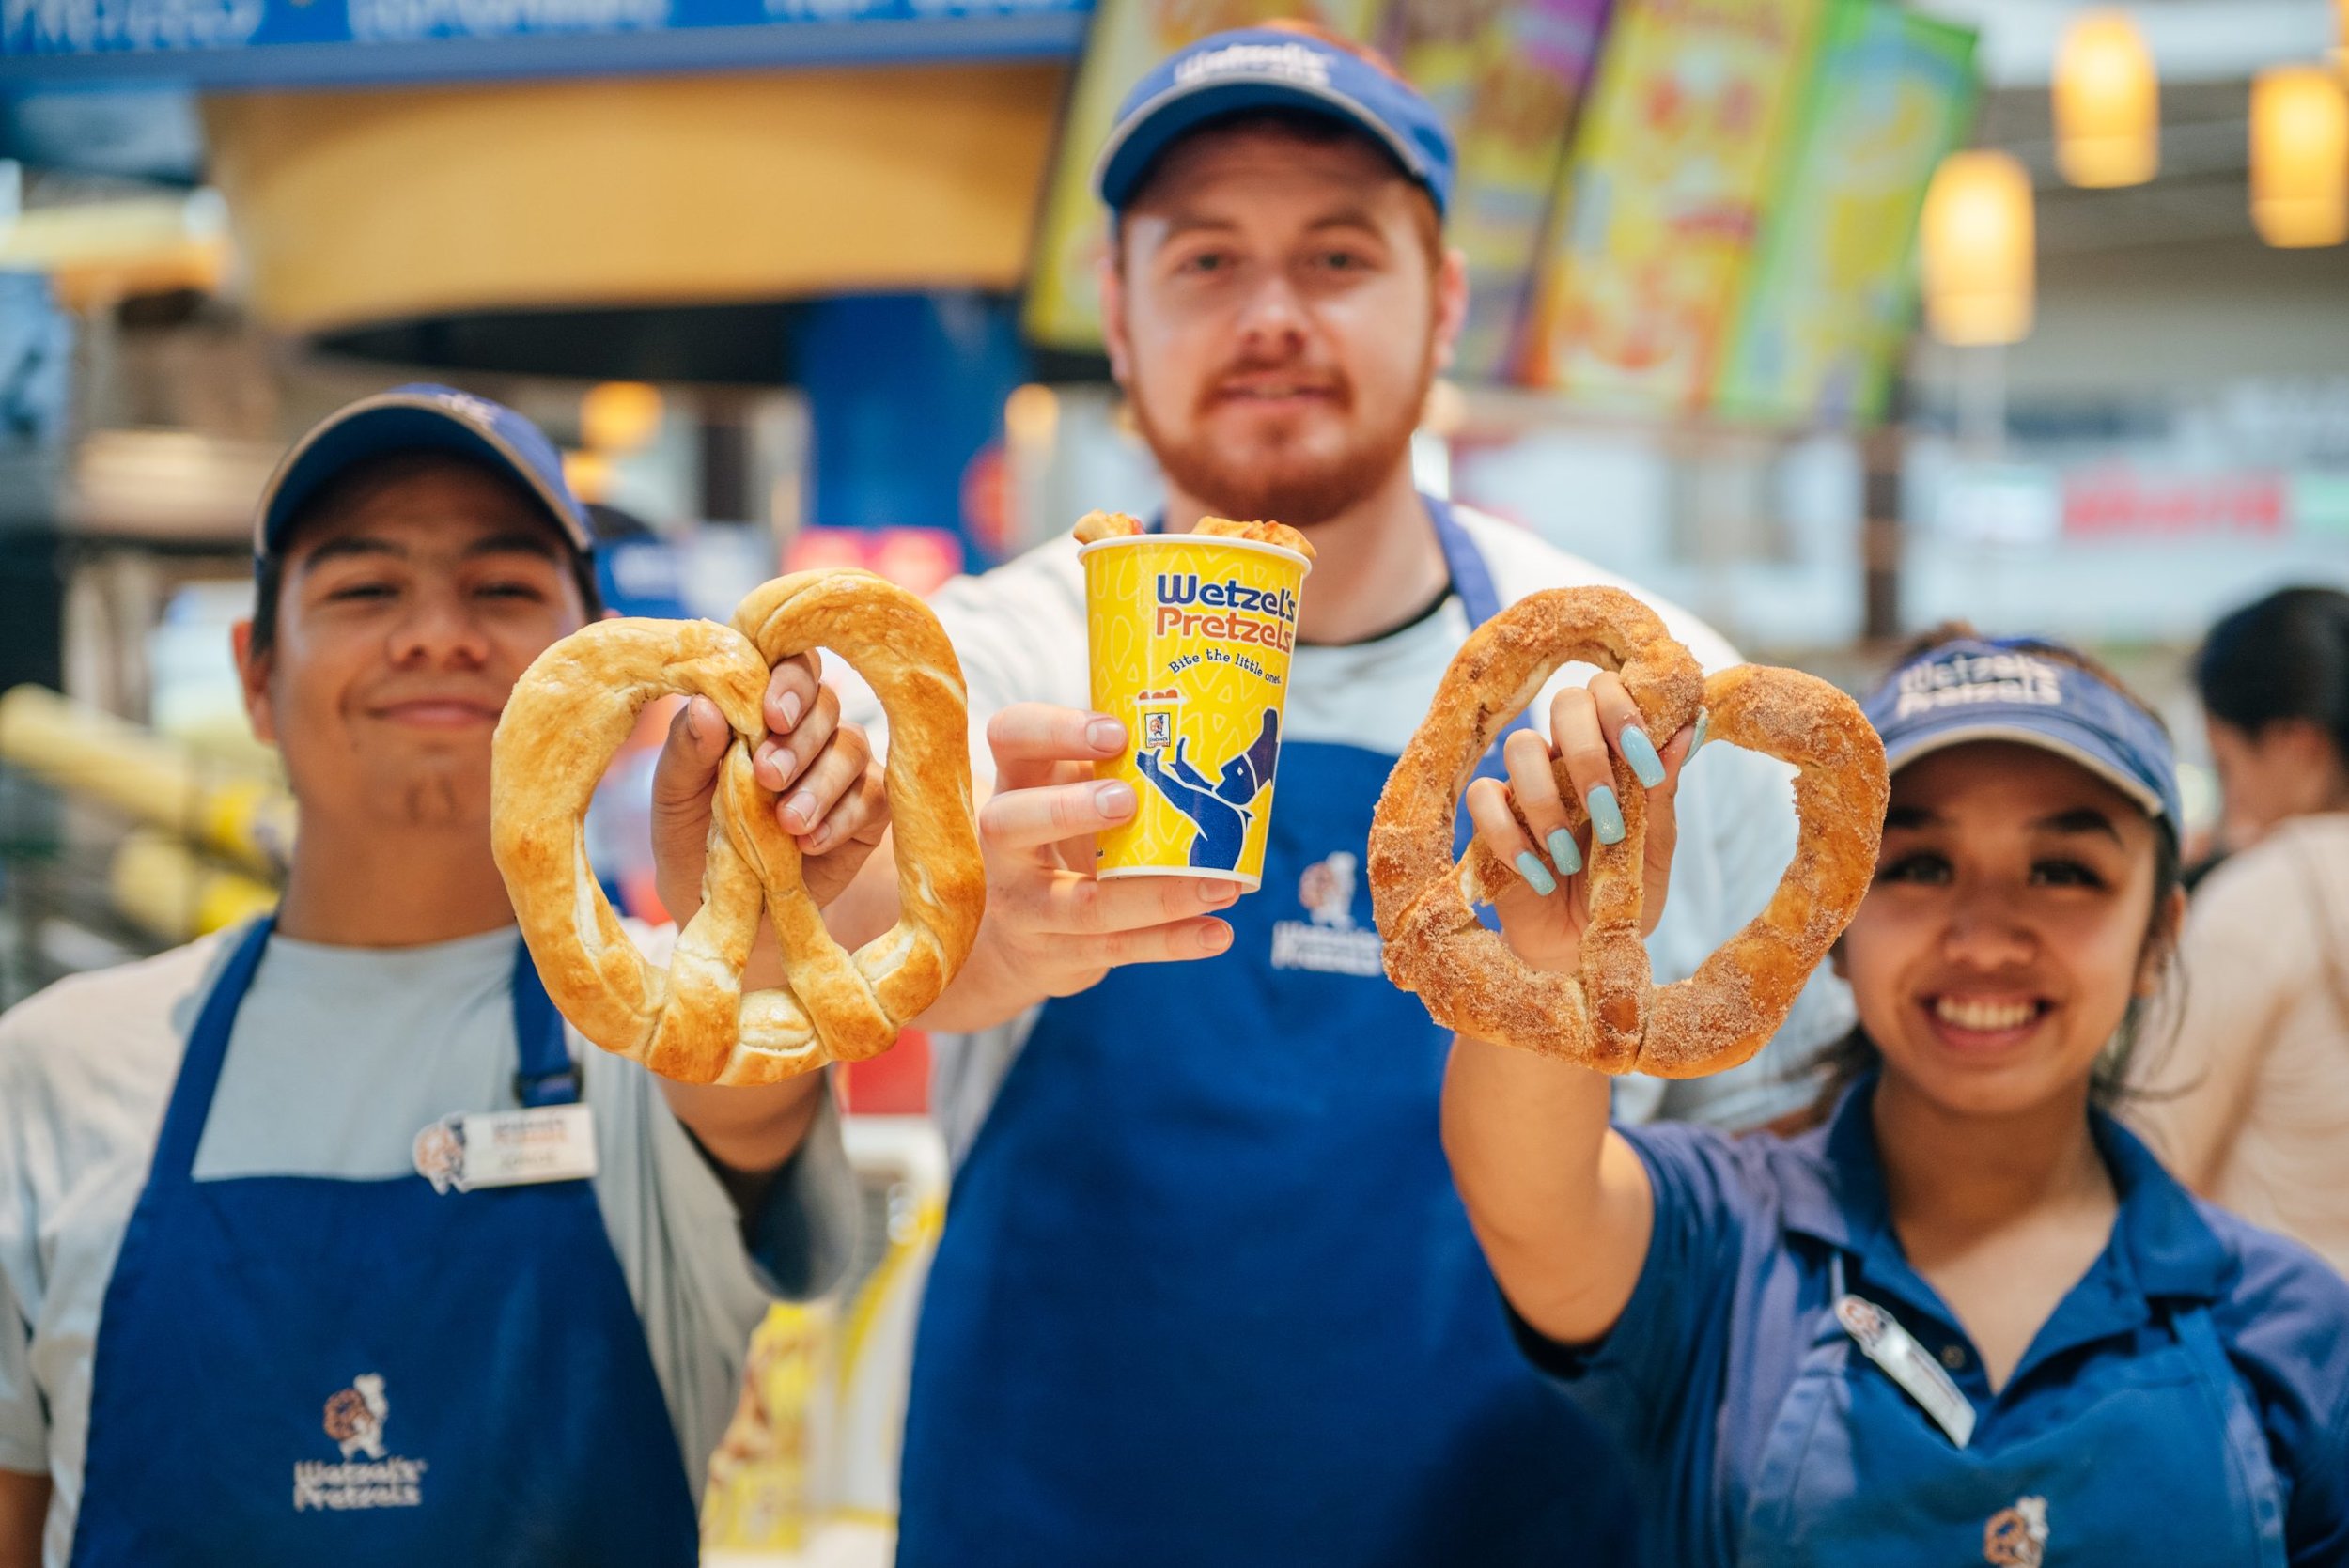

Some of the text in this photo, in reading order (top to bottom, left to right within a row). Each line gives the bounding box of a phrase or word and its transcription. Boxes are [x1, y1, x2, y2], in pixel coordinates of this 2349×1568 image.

[1157, 575, 1296, 622] Wetzel's
[1157, 607, 1292, 653] Pretzels
[1168, 655, 1200, 674] Bite
[1206, 648, 1231, 662] the
[1235, 653, 1263, 676] little
